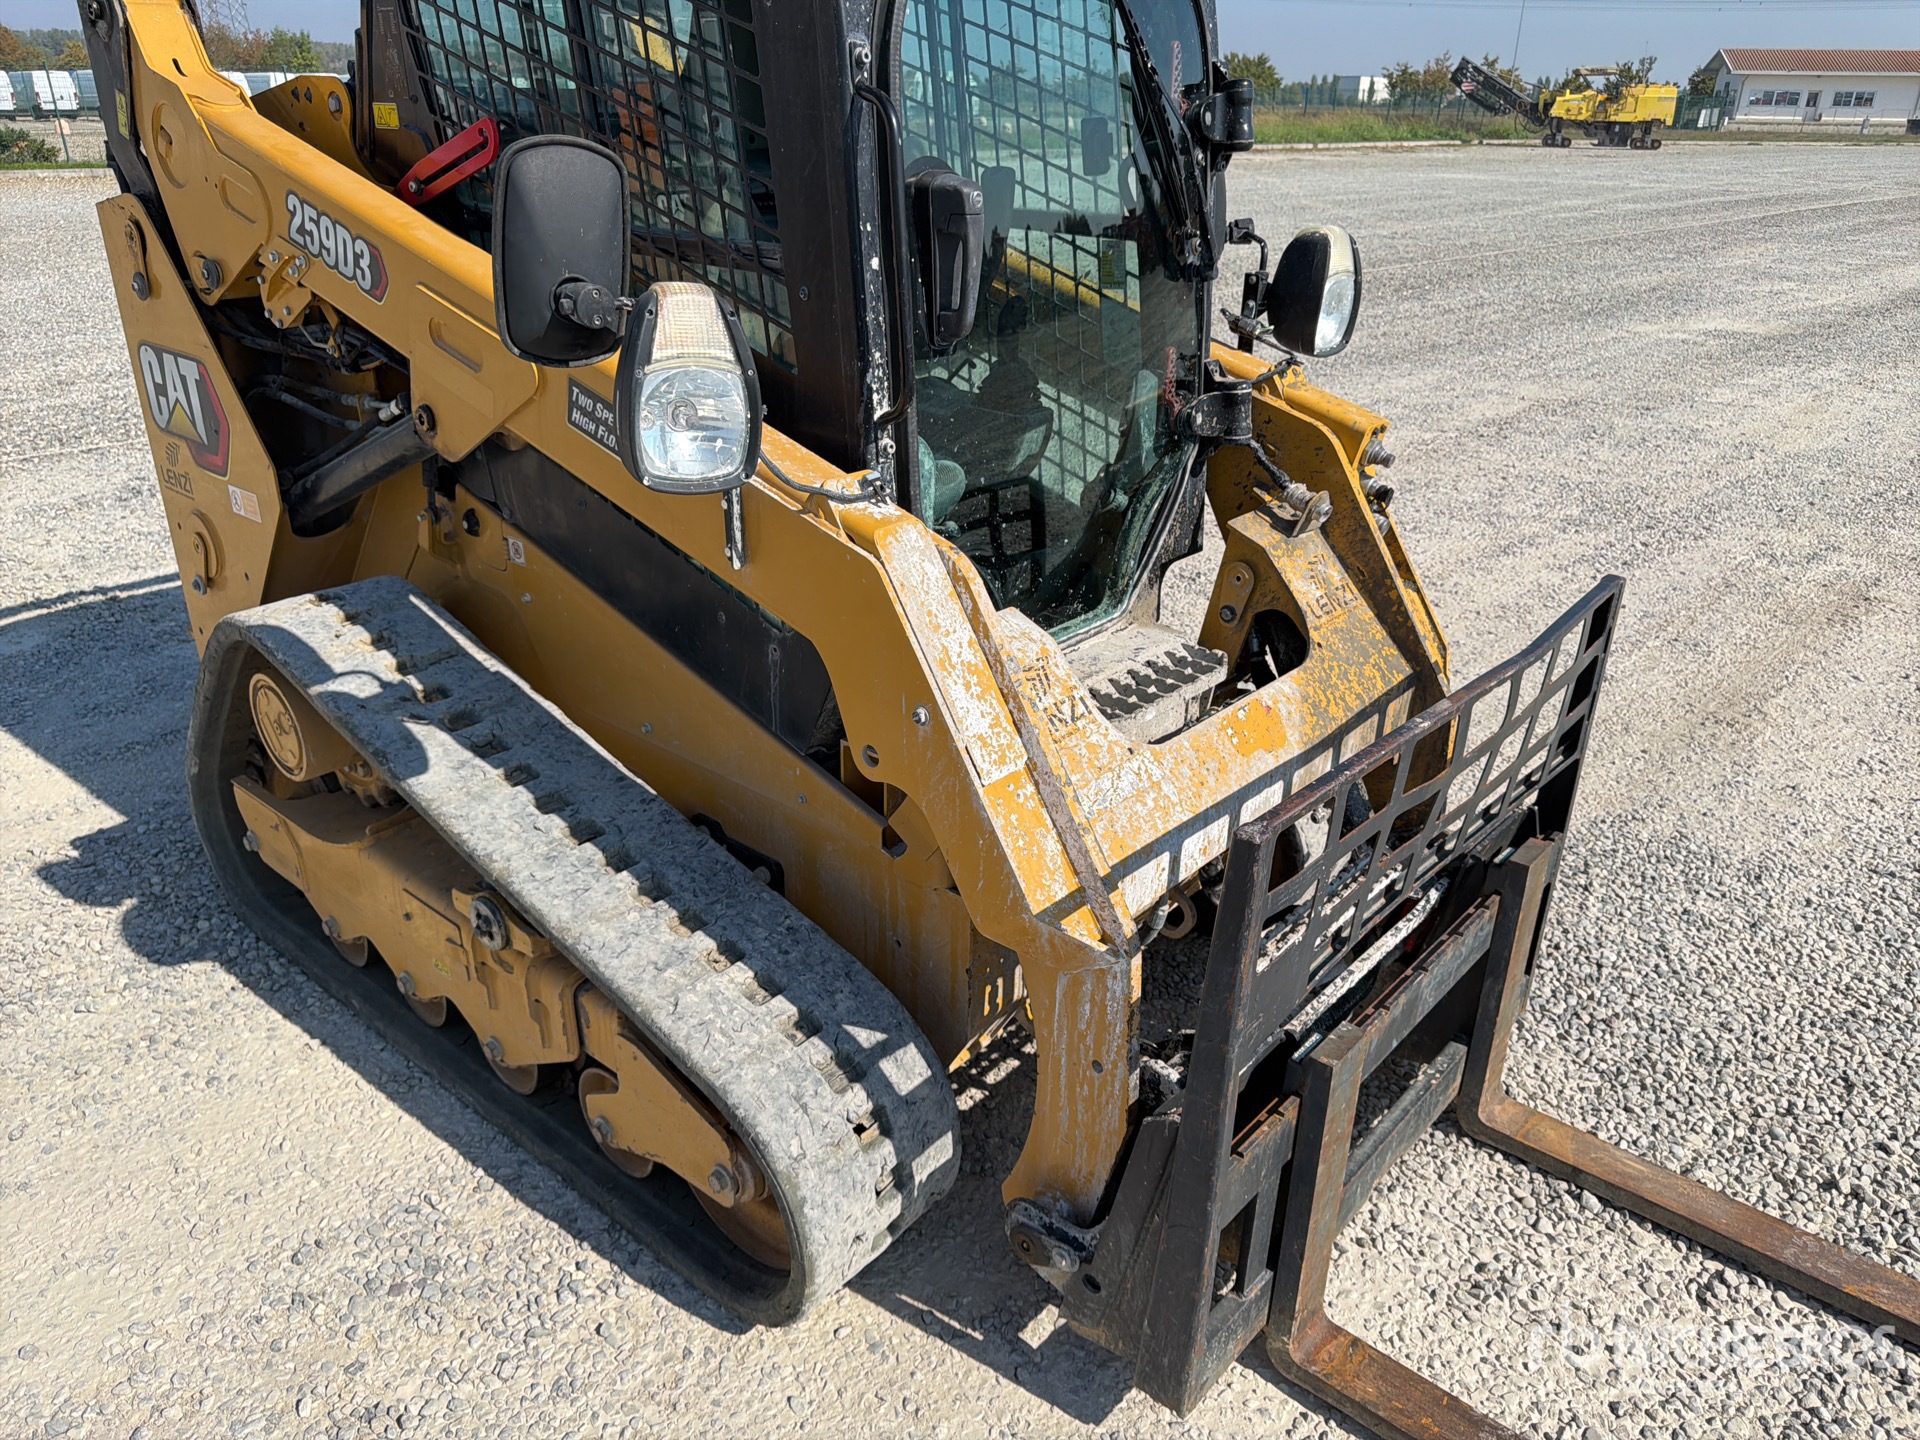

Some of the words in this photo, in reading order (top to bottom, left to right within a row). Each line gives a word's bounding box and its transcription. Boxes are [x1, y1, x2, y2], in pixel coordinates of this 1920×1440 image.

[286, 192, 373, 291] 259D3
[138, 344, 209, 446] CAT
[594, 402, 615, 427] SPE
[597, 426, 619, 452] FLO
